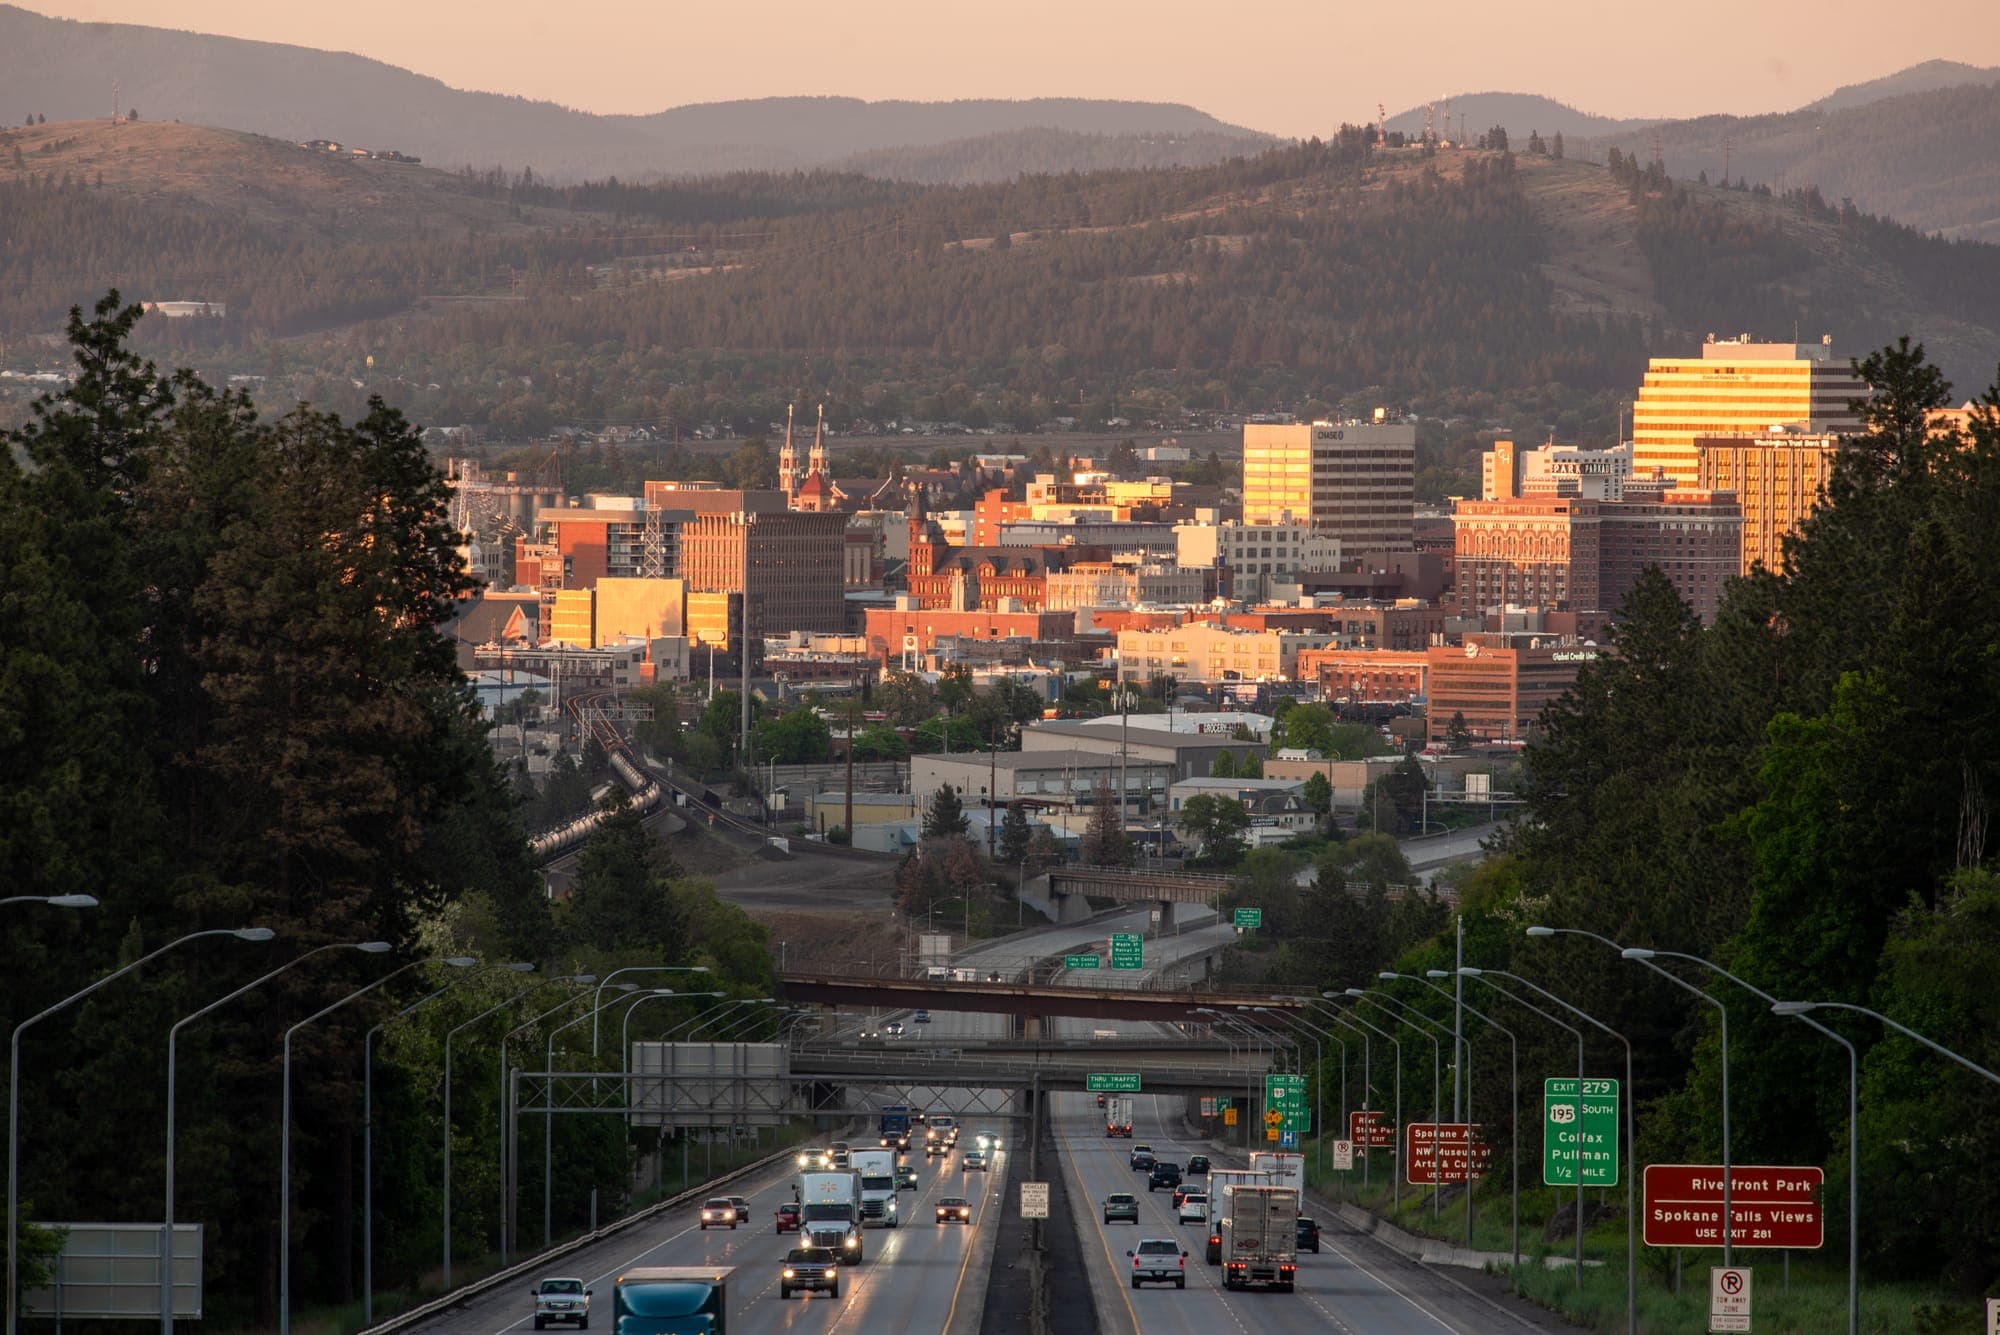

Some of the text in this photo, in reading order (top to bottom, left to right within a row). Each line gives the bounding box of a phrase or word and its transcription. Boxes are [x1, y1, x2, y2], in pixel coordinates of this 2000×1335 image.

[1317, 431, 1338, 440] CHASE
[1754, 440, 1788, 448] Washington
[1553, 463, 1581, 473] PARK
[1553, 1081, 1610, 1093] EXIT 279
[1553, 1108, 1574, 1120] 195
[1415, 1147, 1432, 1156] NW
[1481, 1148, 1491, 1156] of
[1442, 1160, 1449, 1168] &
[1582, 1168, 1606, 1177] MILE
[1691, 1178, 1811, 1192] Rivefront Park
[1654, 1209, 1719, 1223] Spokane
[1770, 1211, 1814, 1223] Views
[1695, 1228, 1717, 1238] USE
[1753, 1229, 1772, 1239] 281
[1716, 1296, 1747, 1304] TOW AWAY
[1723, 1305, 1739, 1313] ZONE
